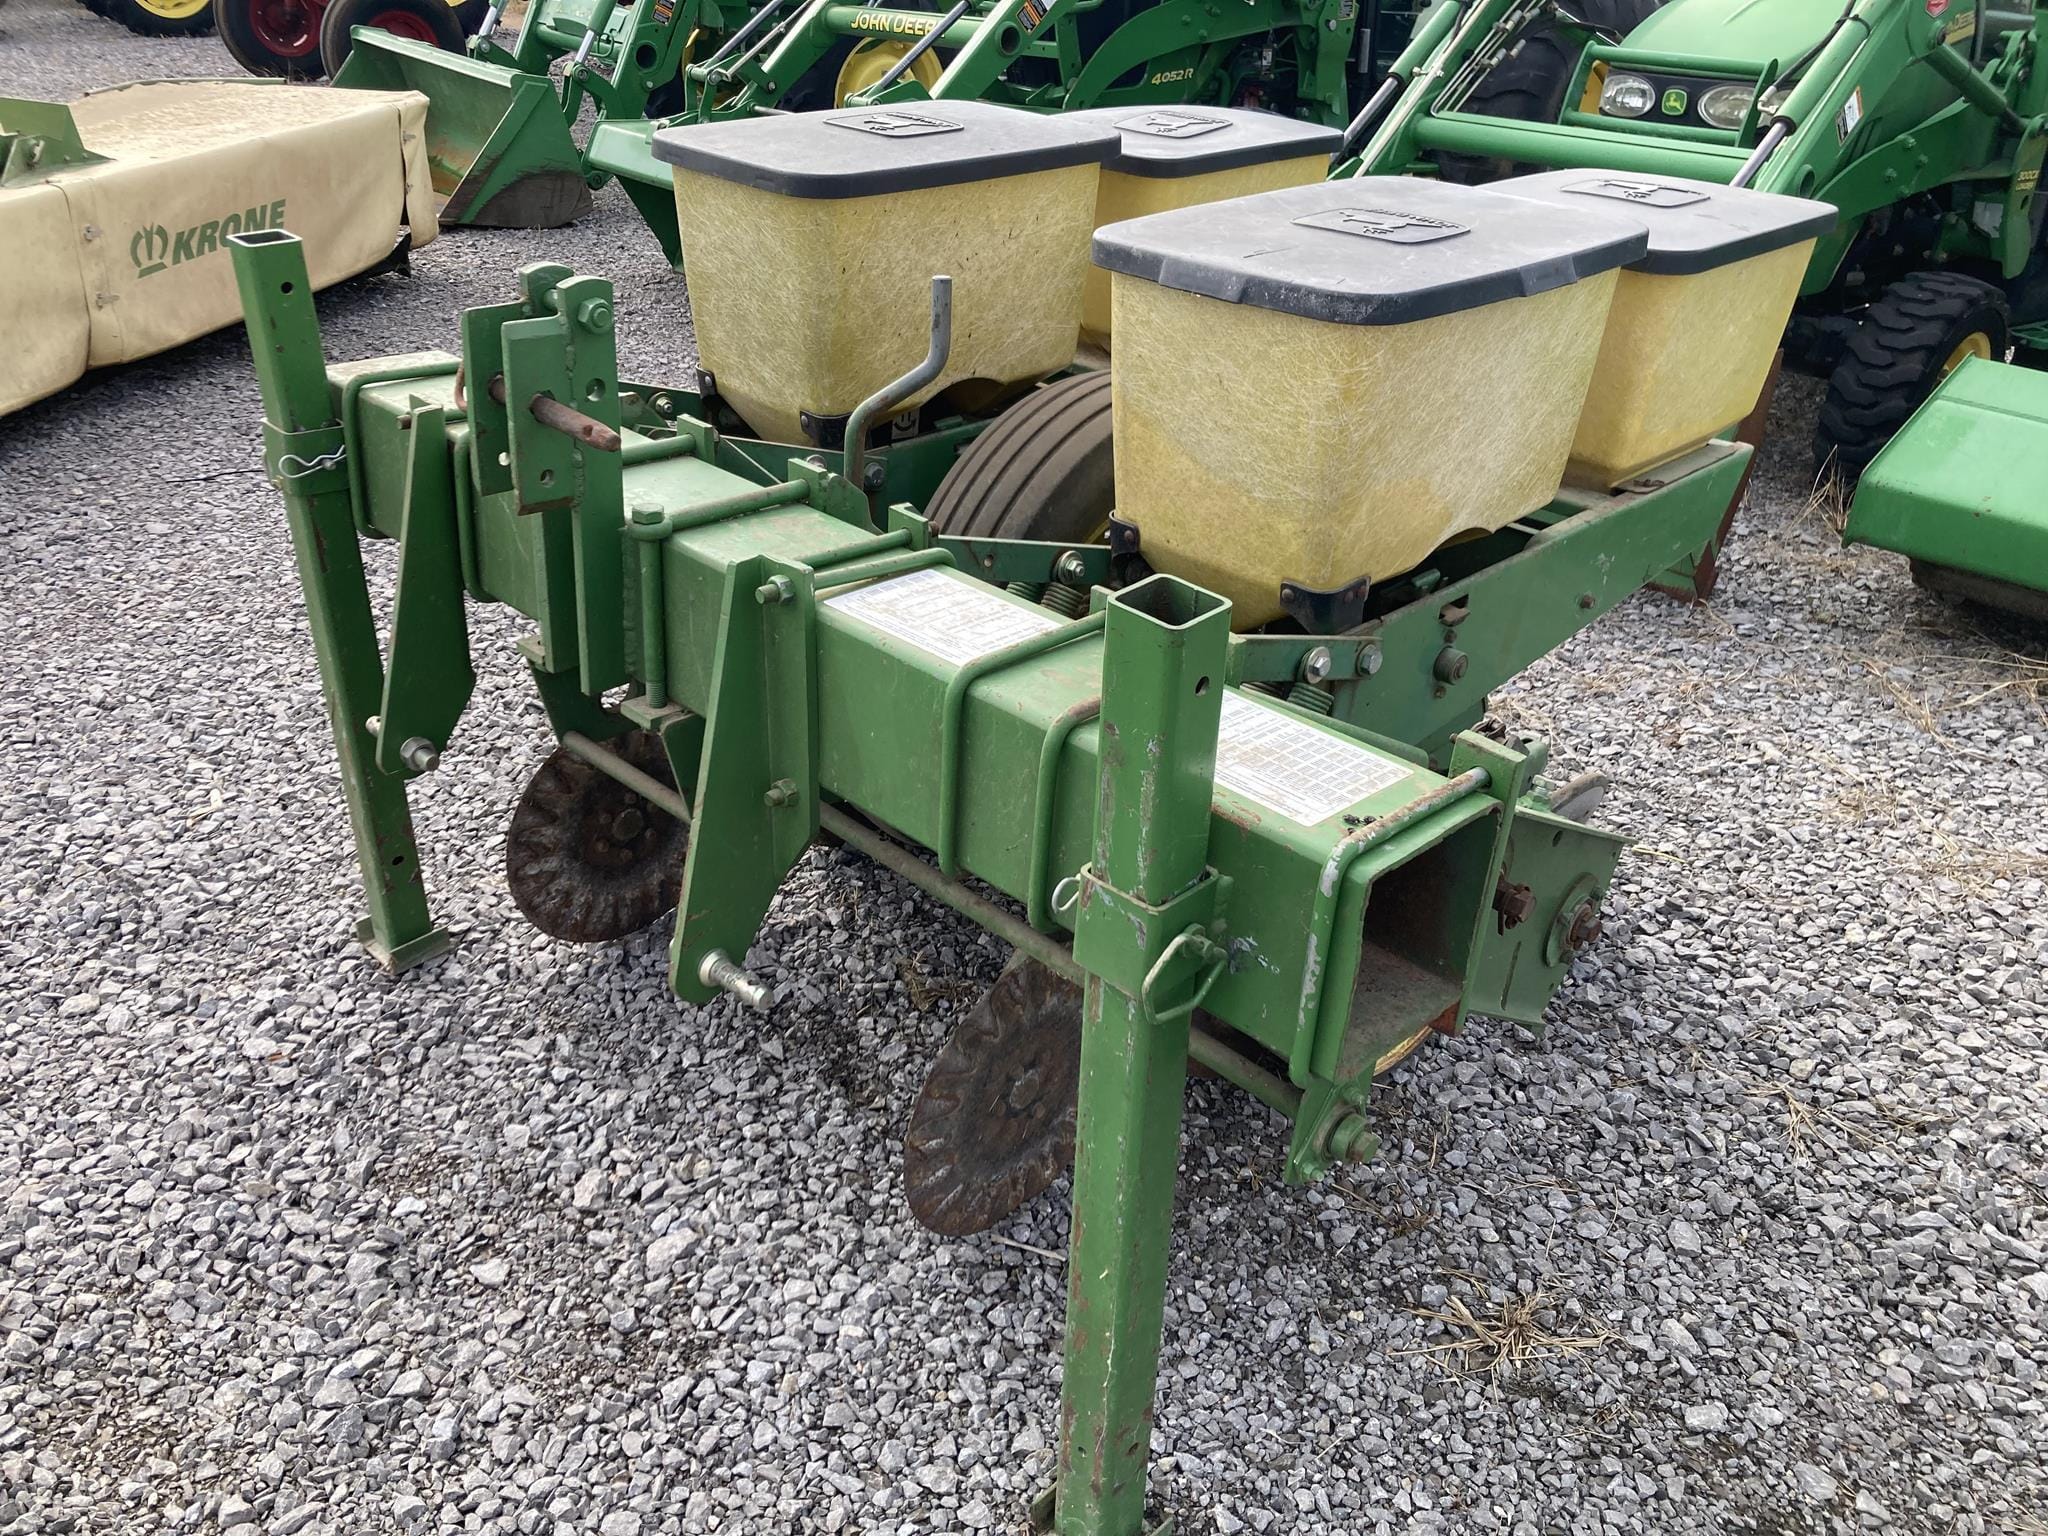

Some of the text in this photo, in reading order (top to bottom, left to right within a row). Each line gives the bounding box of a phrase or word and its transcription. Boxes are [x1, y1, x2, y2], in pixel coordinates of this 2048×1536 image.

[851, 10, 944, 38] JOHN DEER
[1151, 68, 1194, 85] 4052R
[172, 199, 286, 266] KRONE
